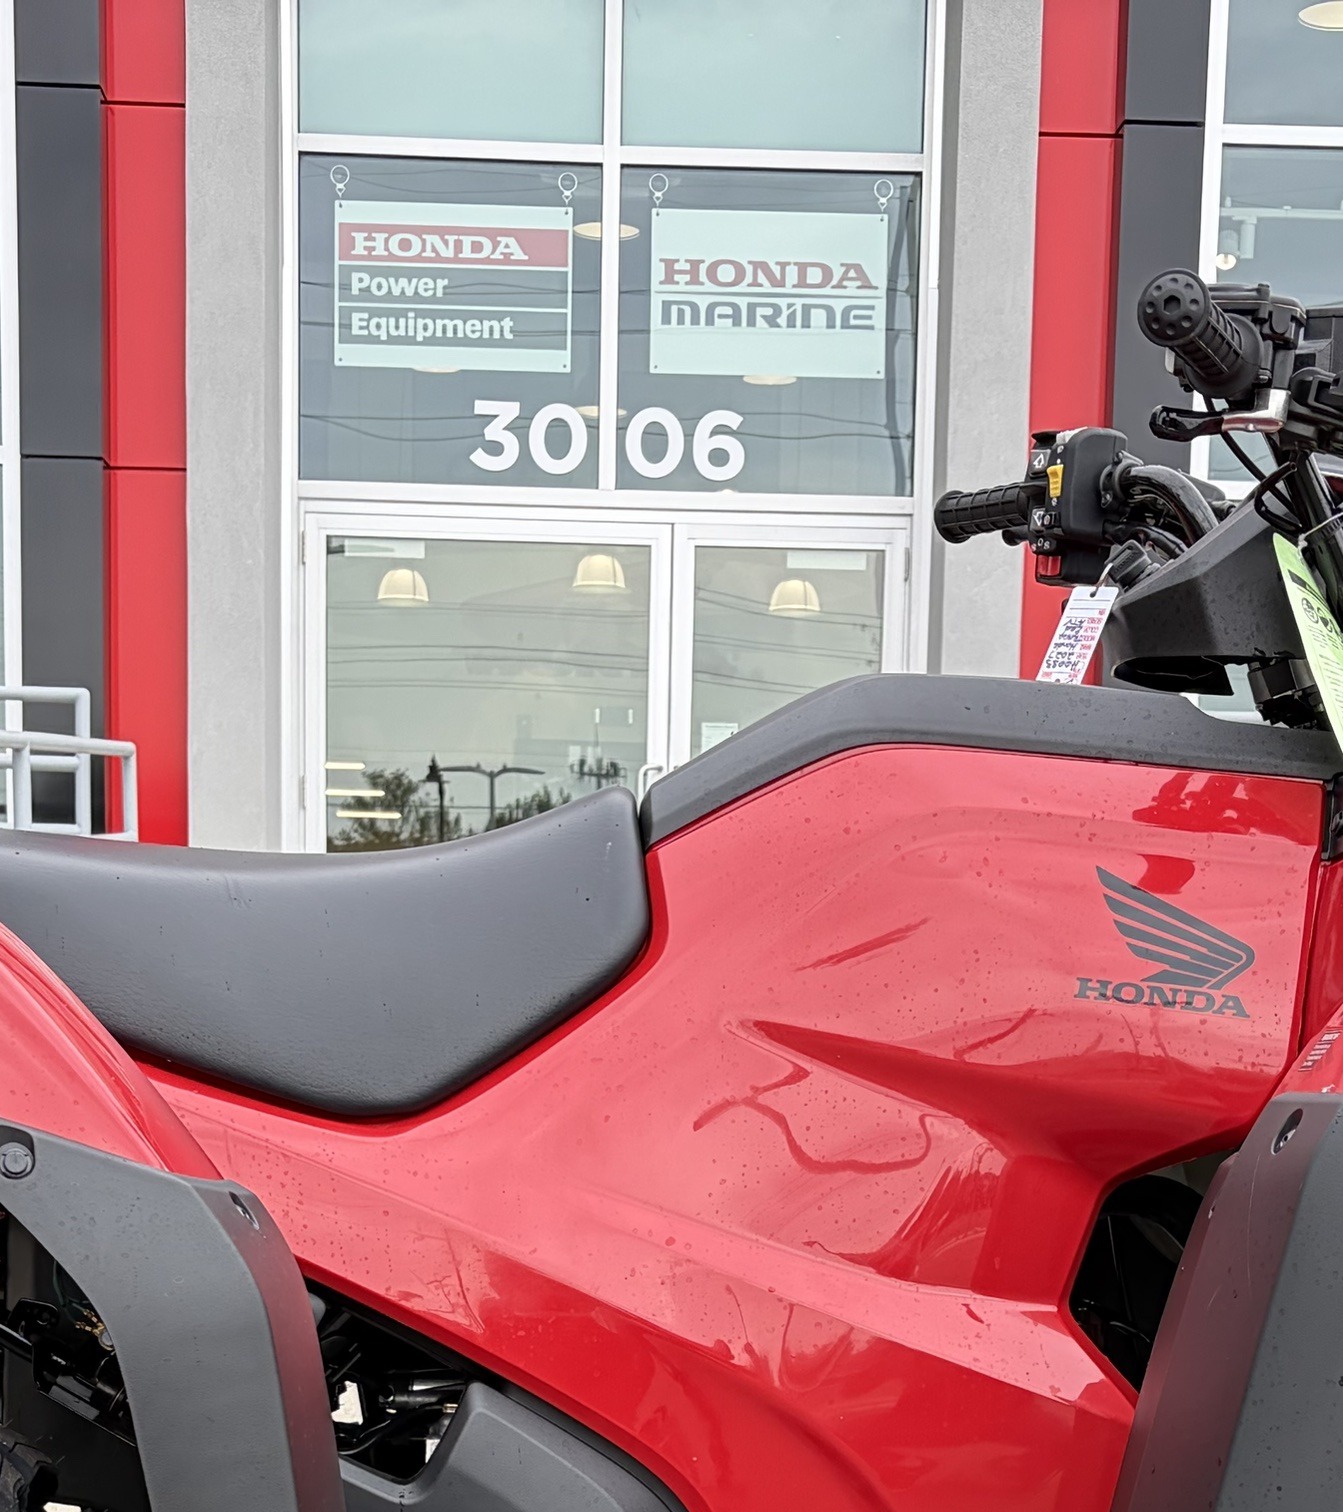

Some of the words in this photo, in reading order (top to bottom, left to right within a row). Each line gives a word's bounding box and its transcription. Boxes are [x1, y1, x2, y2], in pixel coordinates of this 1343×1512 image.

[350, 231, 529, 261] HONDA
[350, 272, 449, 298] Power
[658, 257, 879, 290] HONDA
[350, 313, 515, 341] Equipment
[468, 399, 746, 482] 3006
[1074, 976, 1251, 1019] HONDA
